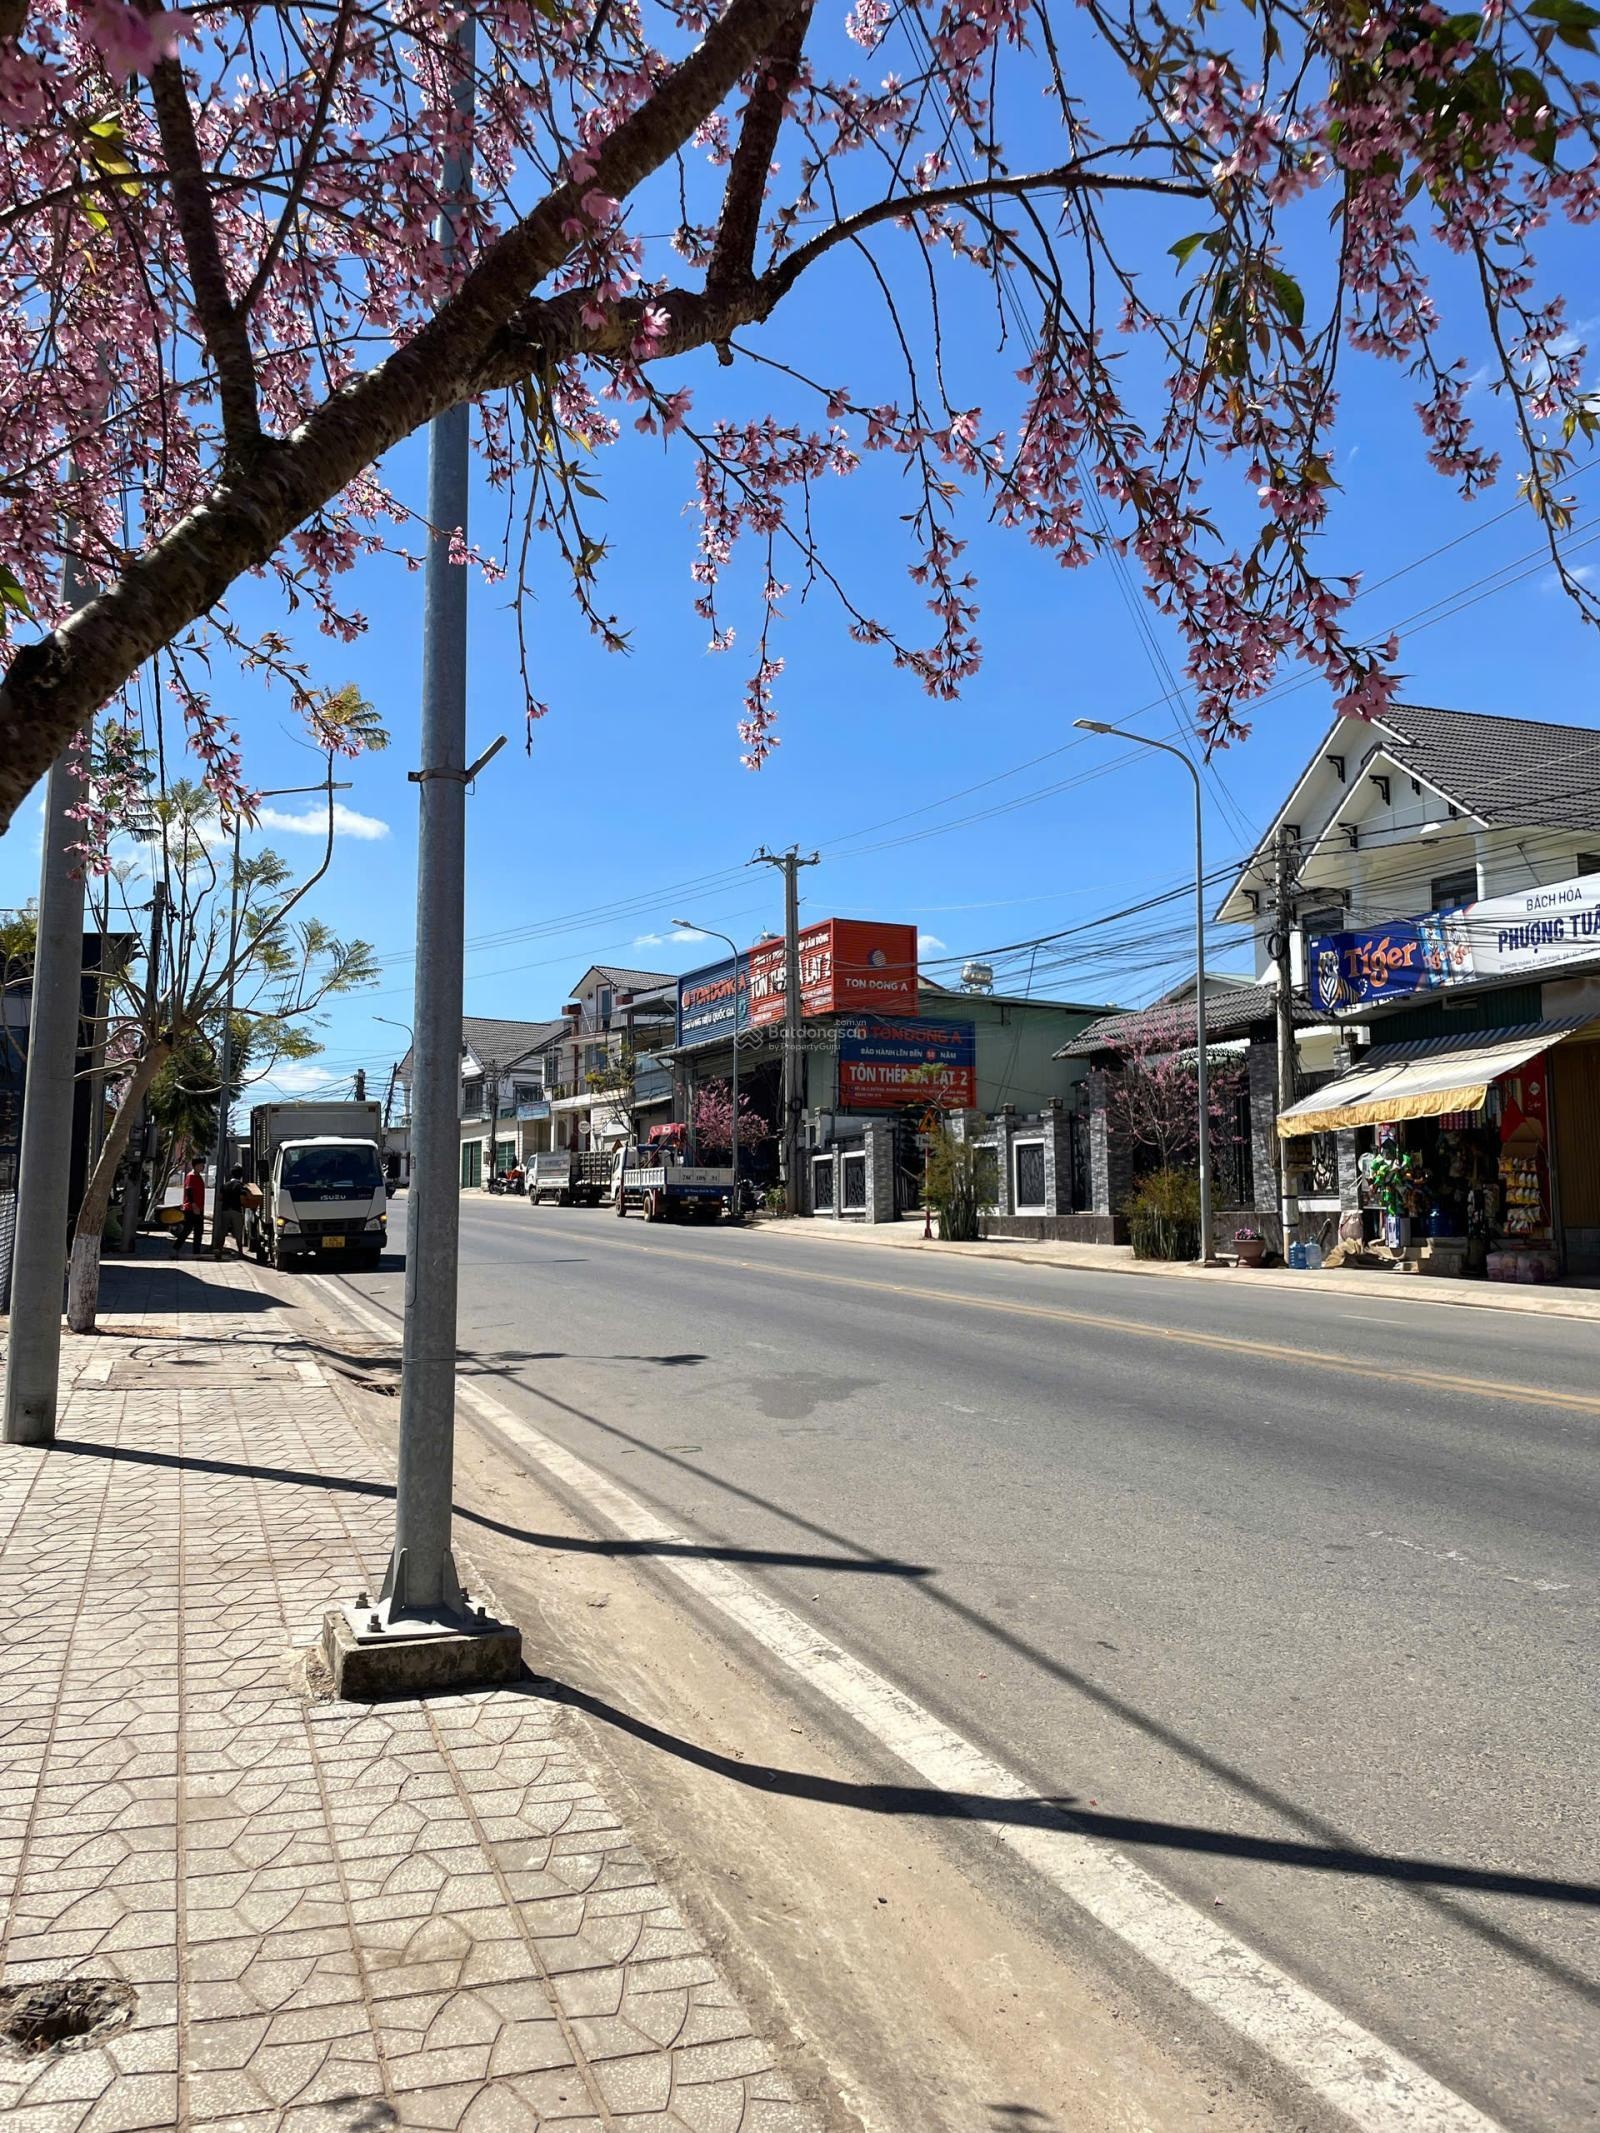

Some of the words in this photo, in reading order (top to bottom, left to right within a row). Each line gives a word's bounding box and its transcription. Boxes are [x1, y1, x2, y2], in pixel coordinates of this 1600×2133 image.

[1526, 893, 1556, 911] BÁCH
[1559, 886, 1582, 904] HÓA
[750, 968, 768, 998] TÔN
[824, 951, 831, 977] 2
[1345, 936, 1418, 988] Tiger
[845, 978, 866, 988] TON
[869, 980, 898, 991] DONG
[900, 982, 908, 991] A
[849, 1062, 876, 1082] TÔN
[878, 1063, 907, 1084] THÉP
[960, 1071, 968, 1086] 2
